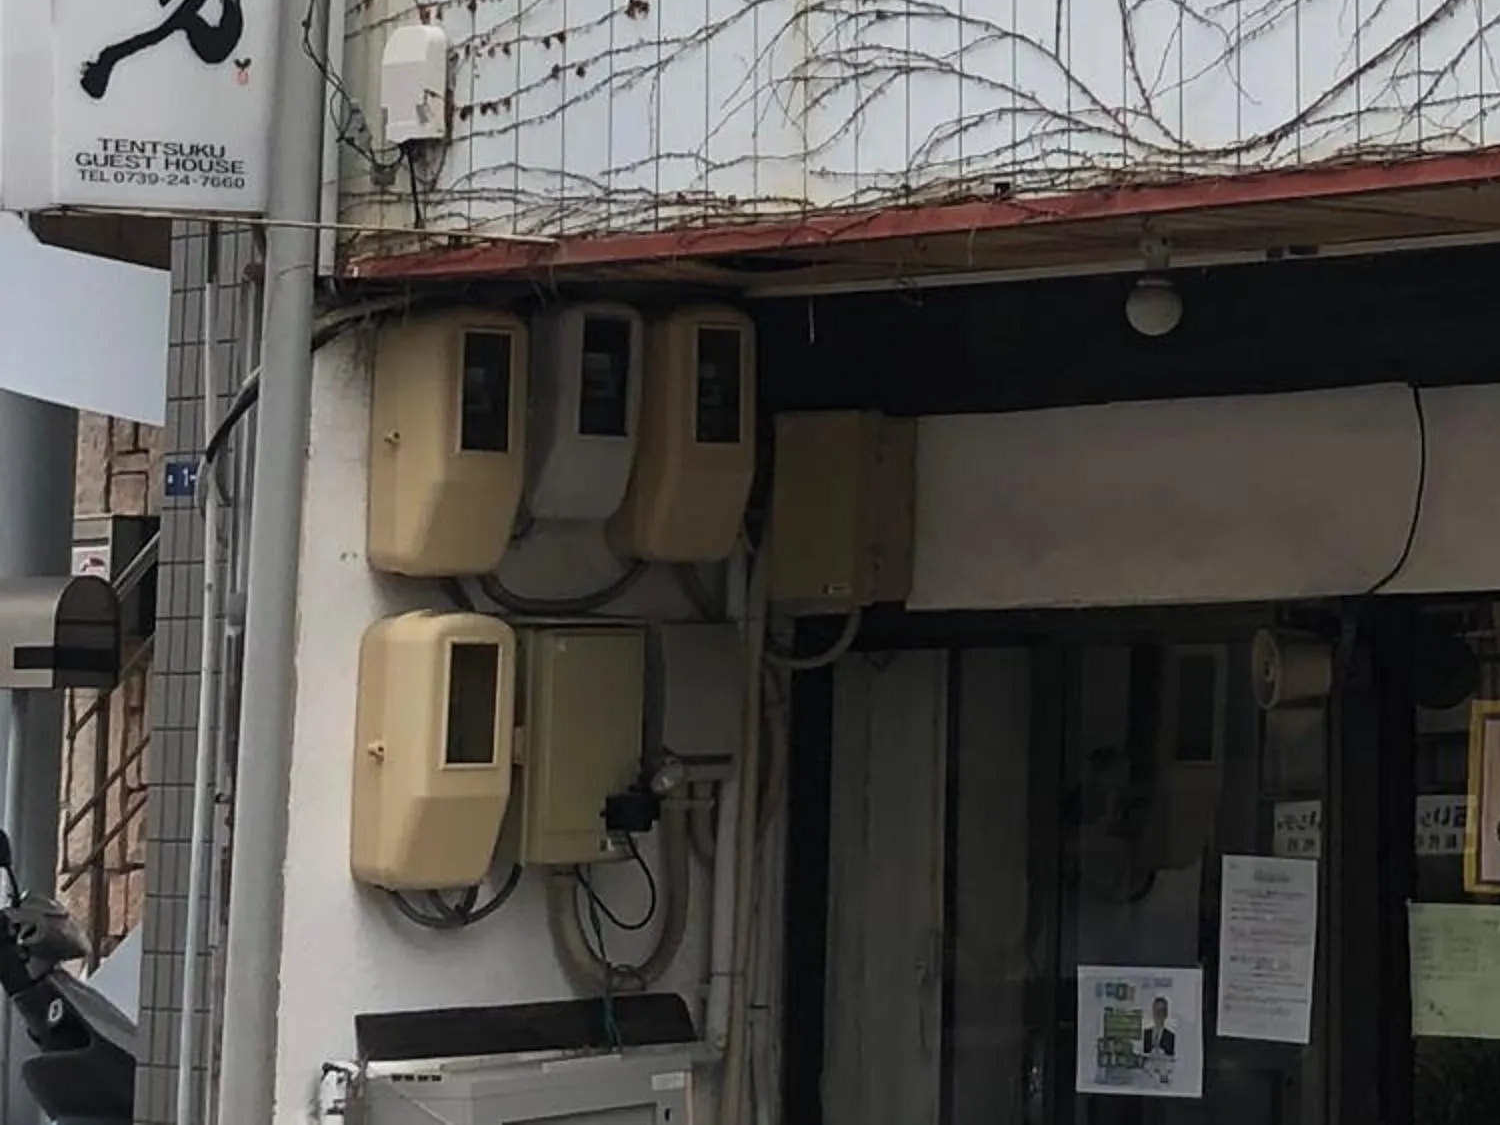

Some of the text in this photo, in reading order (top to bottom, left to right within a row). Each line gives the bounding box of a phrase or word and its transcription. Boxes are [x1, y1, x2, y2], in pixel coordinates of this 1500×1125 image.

[98, 138, 226, 158] TENTSUKU
[75, 152, 246, 174] GUEST HOUSE
[78, 170, 110, 183] TEL
